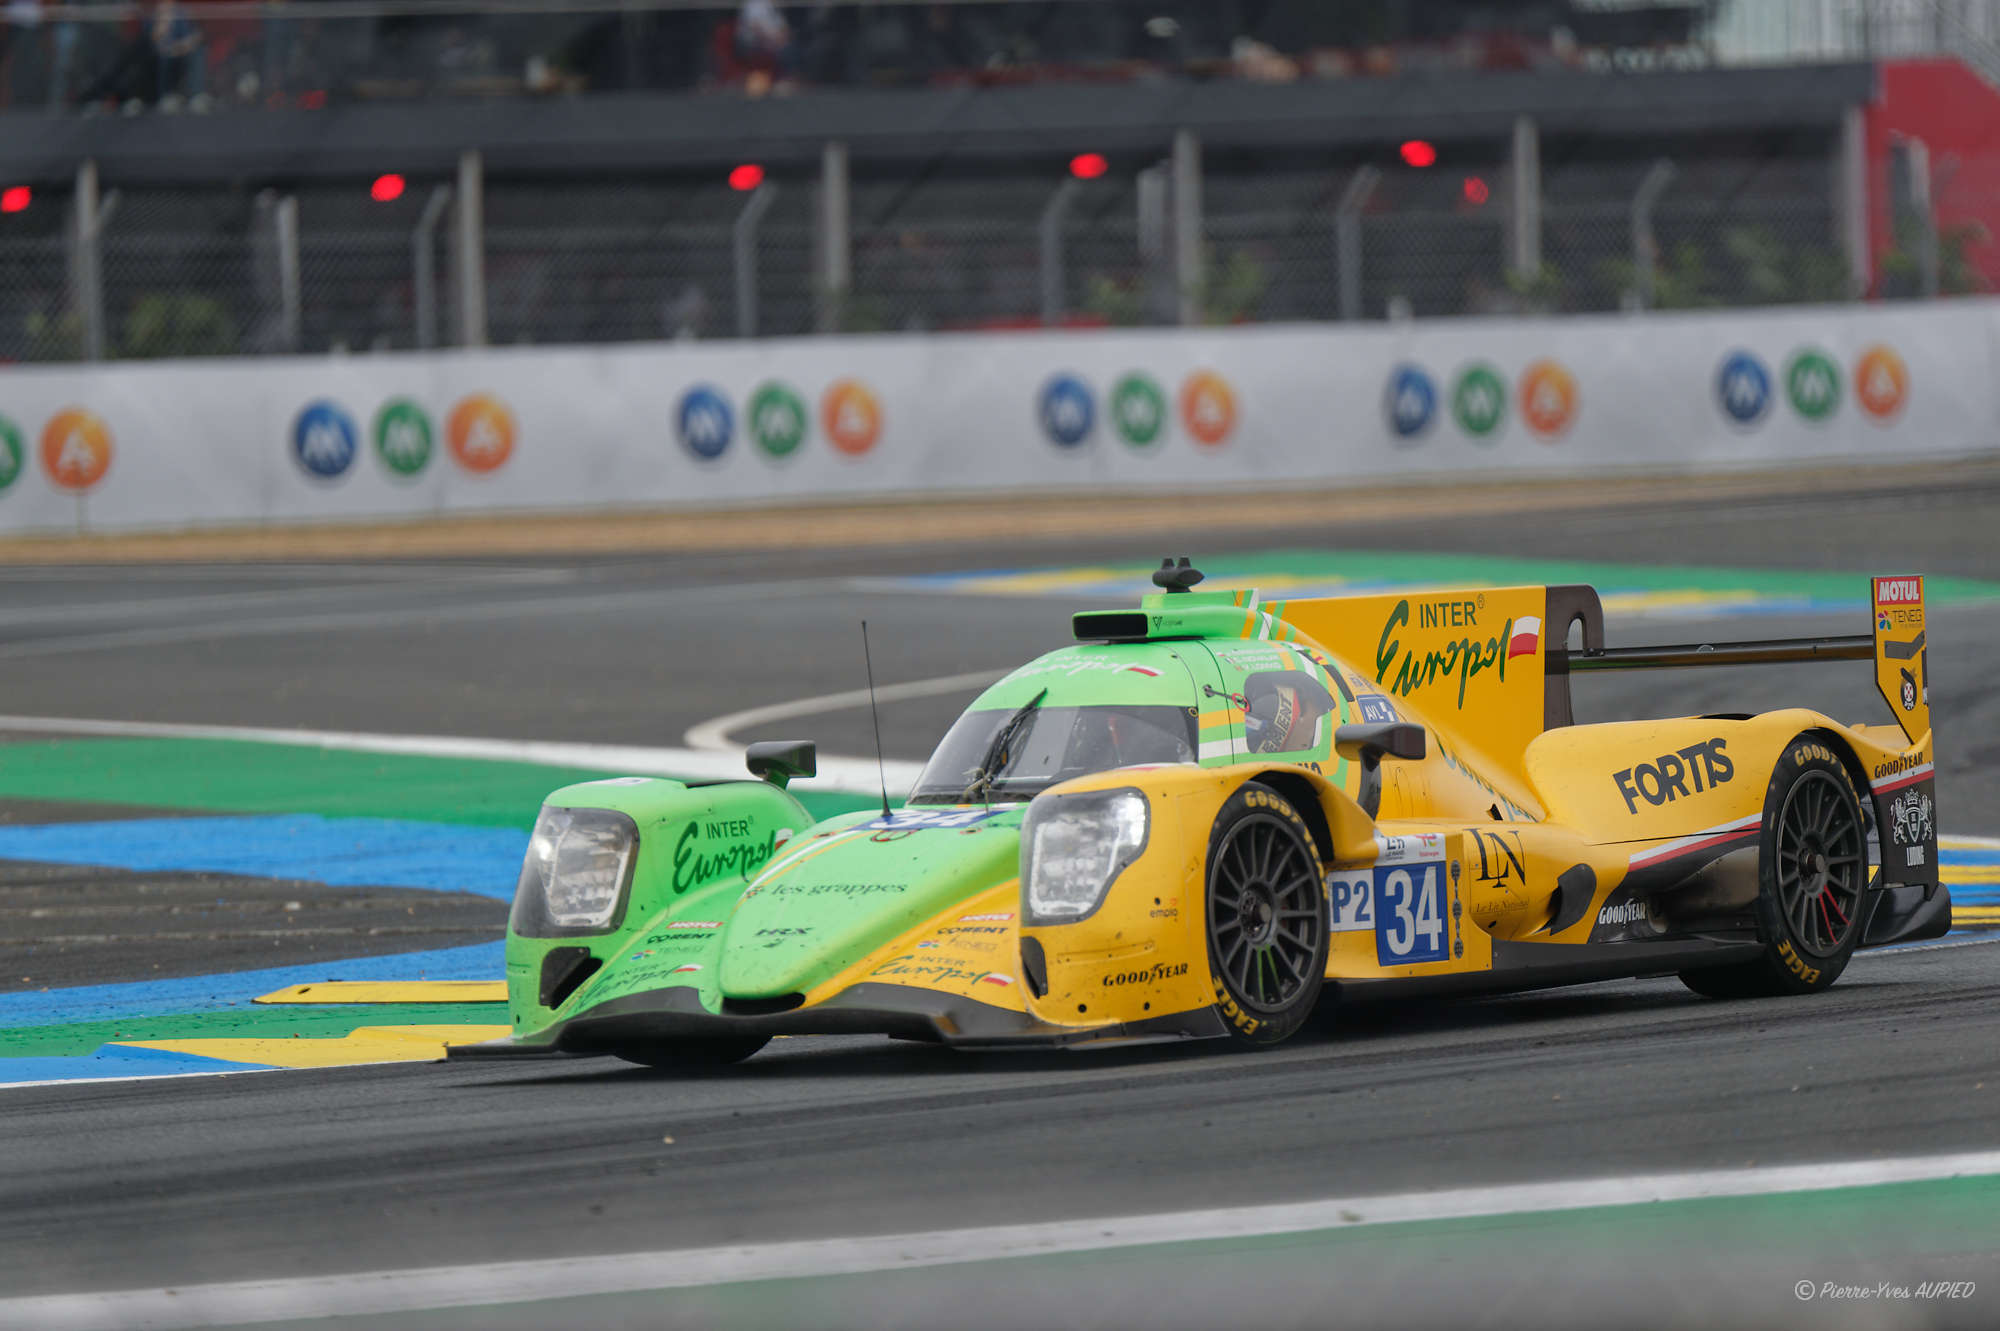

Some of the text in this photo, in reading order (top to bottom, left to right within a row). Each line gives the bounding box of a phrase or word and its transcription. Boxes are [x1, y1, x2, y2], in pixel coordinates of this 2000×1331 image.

[1878, 580, 1919, 601] MOTUL
[1420, 601, 1477, 628] INTER
[1376, 599, 1512, 710] Europol
[1613, 738, 1734, 815] FORTIS
[1874, 752, 1923, 778] GOODYEAR
[706, 820, 750, 840] INTER
[1332, 880, 1371, 923] P2
[1385, 866, 1442, 955] 34
[1599, 897, 1648, 928] GOODYEAR
[1102, 962, 1188, 986] GOODYEAR
[1776, 938, 1821, 984] EAGLE
[1213, 975, 1259, 1035] EAGLE
